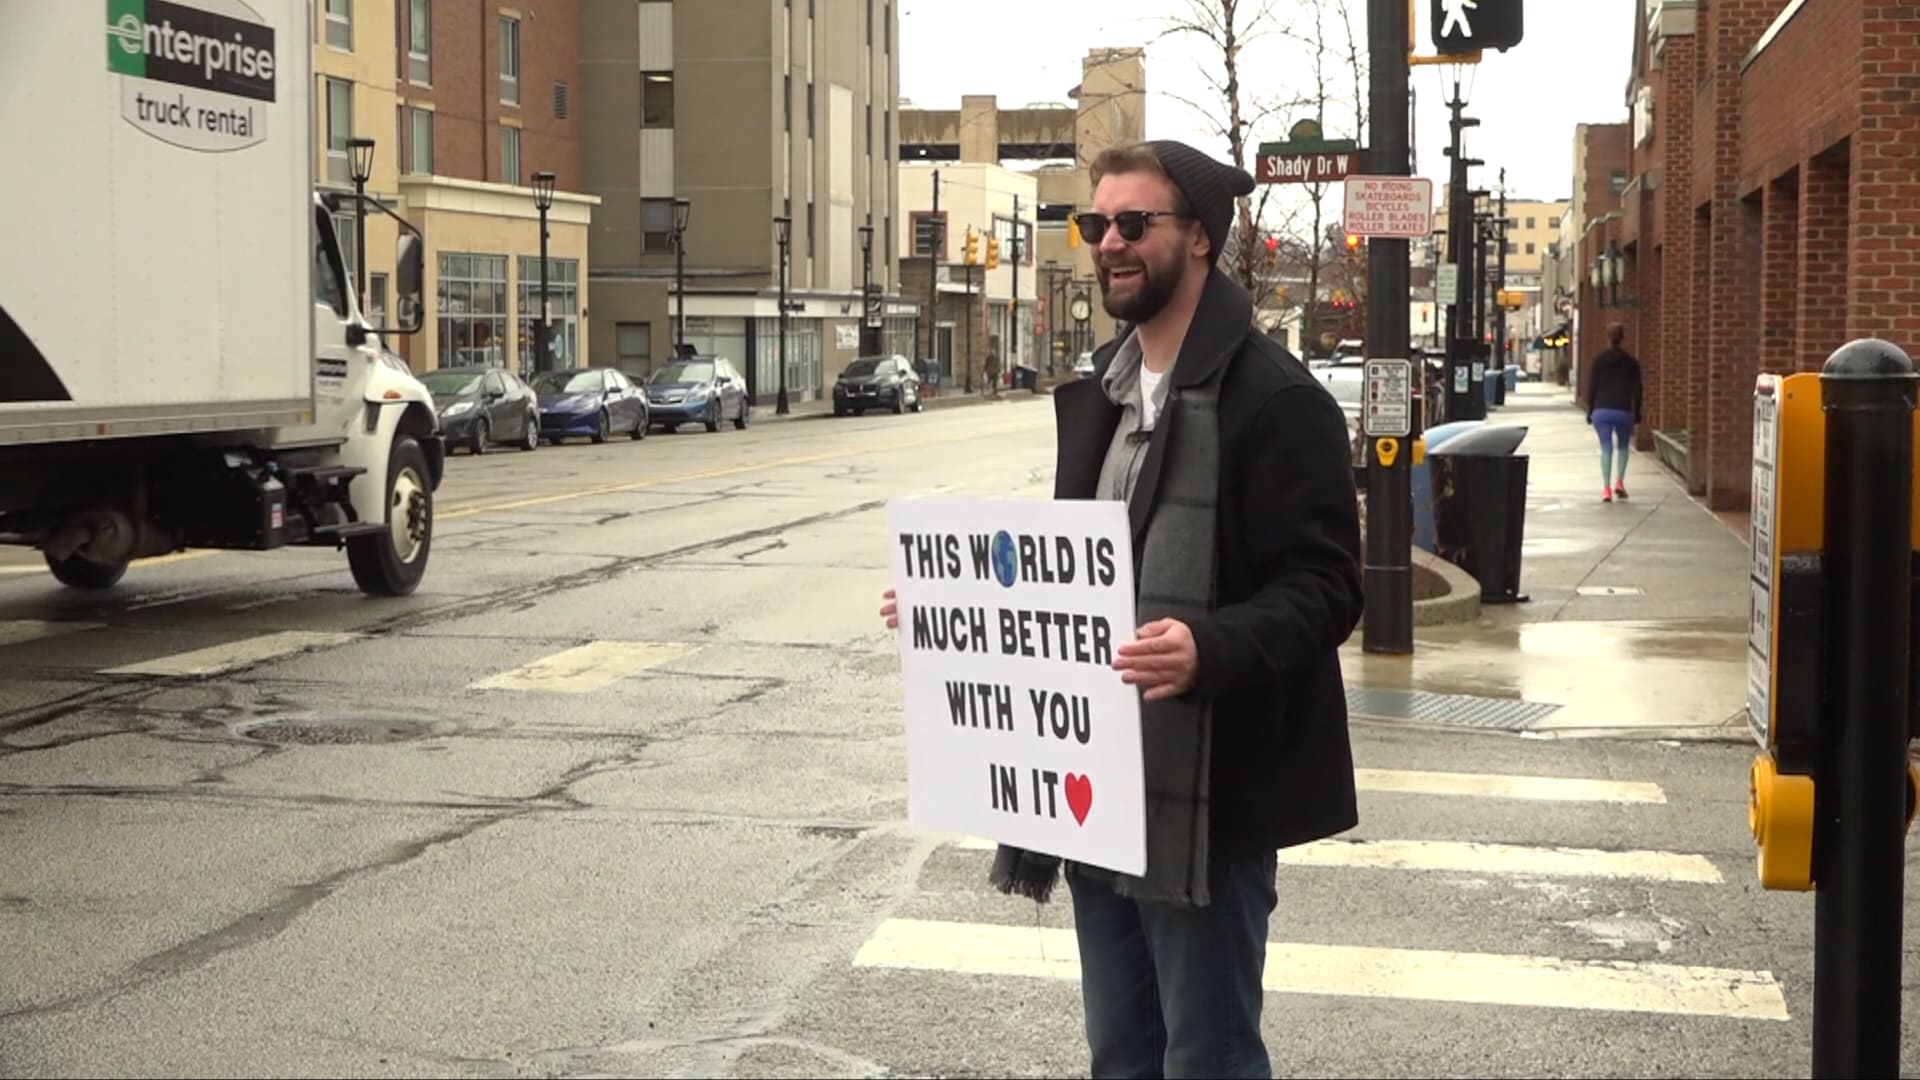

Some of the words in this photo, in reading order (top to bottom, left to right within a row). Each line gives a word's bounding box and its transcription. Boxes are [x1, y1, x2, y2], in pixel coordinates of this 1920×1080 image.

[115, 14, 274, 80] enterprise
[136, 92, 191, 129] truck
[197, 106, 254, 137] rental
[1267, 154, 1311, 181] Shady
[1317, 155, 1332, 174] Dr
[1336, 154, 1349, 174] W
[1355, 191, 1422, 202] SKATEBOARDS
[1364, 181, 1378, 191] NO
[1382, 181, 1413, 191] RIDING
[1348, 212, 1384, 221] ROLLER
[1388, 212, 1425, 222] BLADES
[1365, 202, 1410, 211] BICYCLES
[1348, 222, 1384, 232] ROLLER
[1390, 222, 1425, 232] SKATES
[899, 532, 961, 580] THIS
[1086, 535, 1116, 587] IS
[911, 604, 989, 654] MUCH
[999, 608, 1113, 665] BETTER
[945, 680, 1015, 732] WITH
[1028, 688, 1092, 745] YOU
[989, 763, 1019, 813] IN
[1031, 767, 1059, 819] IT
